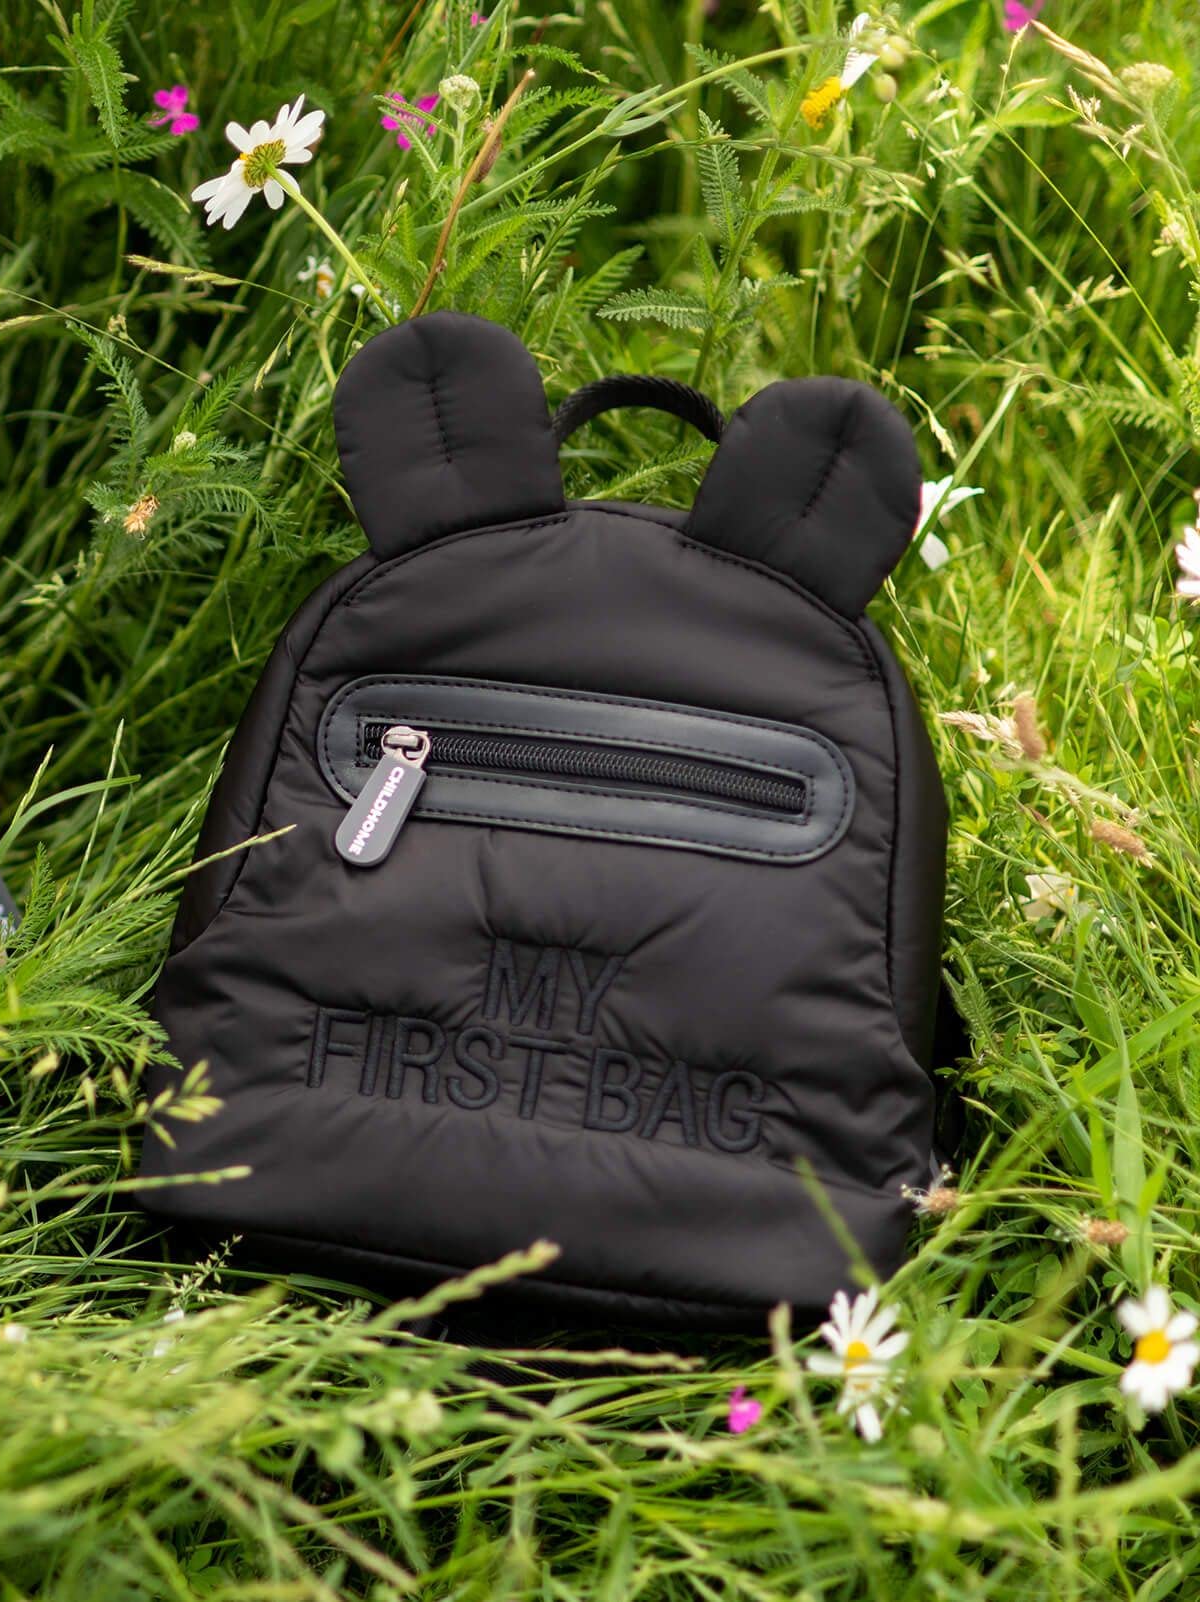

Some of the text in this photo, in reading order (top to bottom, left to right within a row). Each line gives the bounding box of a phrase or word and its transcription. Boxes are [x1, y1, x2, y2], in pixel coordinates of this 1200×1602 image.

[348, 766, 405, 856] CHILDHOME
[481, 937, 627, 1036] MY
[305, 1005, 765, 1154] FIRST BAG
